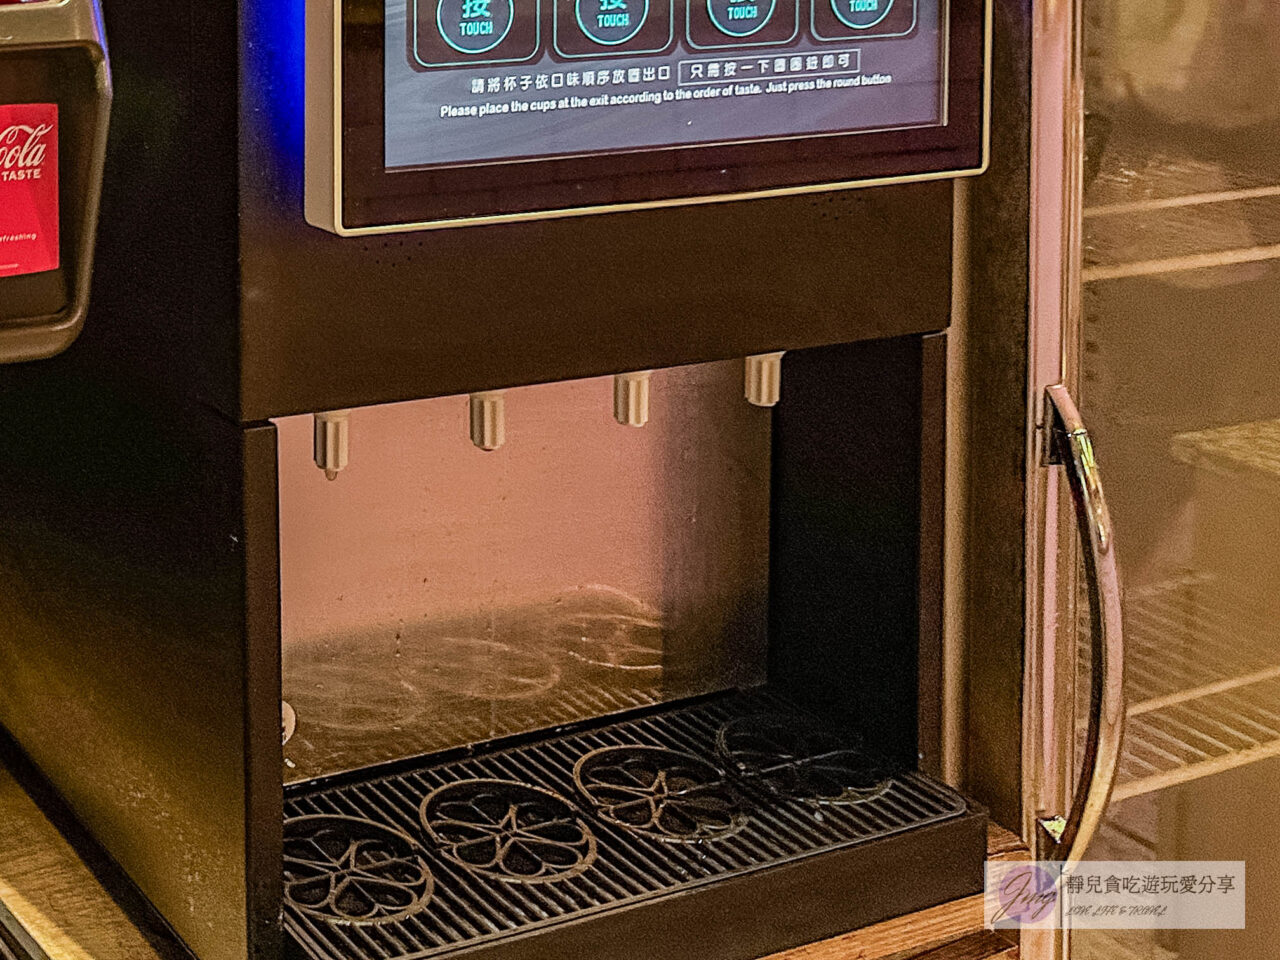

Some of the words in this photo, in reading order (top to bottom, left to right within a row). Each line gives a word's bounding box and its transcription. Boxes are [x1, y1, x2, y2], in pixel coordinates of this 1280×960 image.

[727, 5, 758, 20] TOUCH
[597, 13, 629, 28] TOUCH
[459, 21, 493, 36] TOUCH
[471, 65, 670, 94] 請將杯子依口味順序放置出口
[440, 104, 477, 118] Please
[479, 102, 509, 115] place
[511, 100, 529, 112] the
[530, 100, 557, 113] cups
[558, 98, 569, 109] at
[570, 96, 588, 108] the
[589, 94, 609, 107] exit
[610, 90, 662, 105] according
[663, 90, 674, 101] to
[675, 88, 692, 101] the
[693, 86, 720, 99] order
[722, 85, 733, 97] of
[734, 84, 763, 96] taste.
[766, 81, 787, 94] Just
[788, 80, 815, 94] press
[816, 78, 832, 90] the
[833, 76, 860, 88] round
[861, 73, 892, 86] button
[1, 169, 41, 181] TASTE
